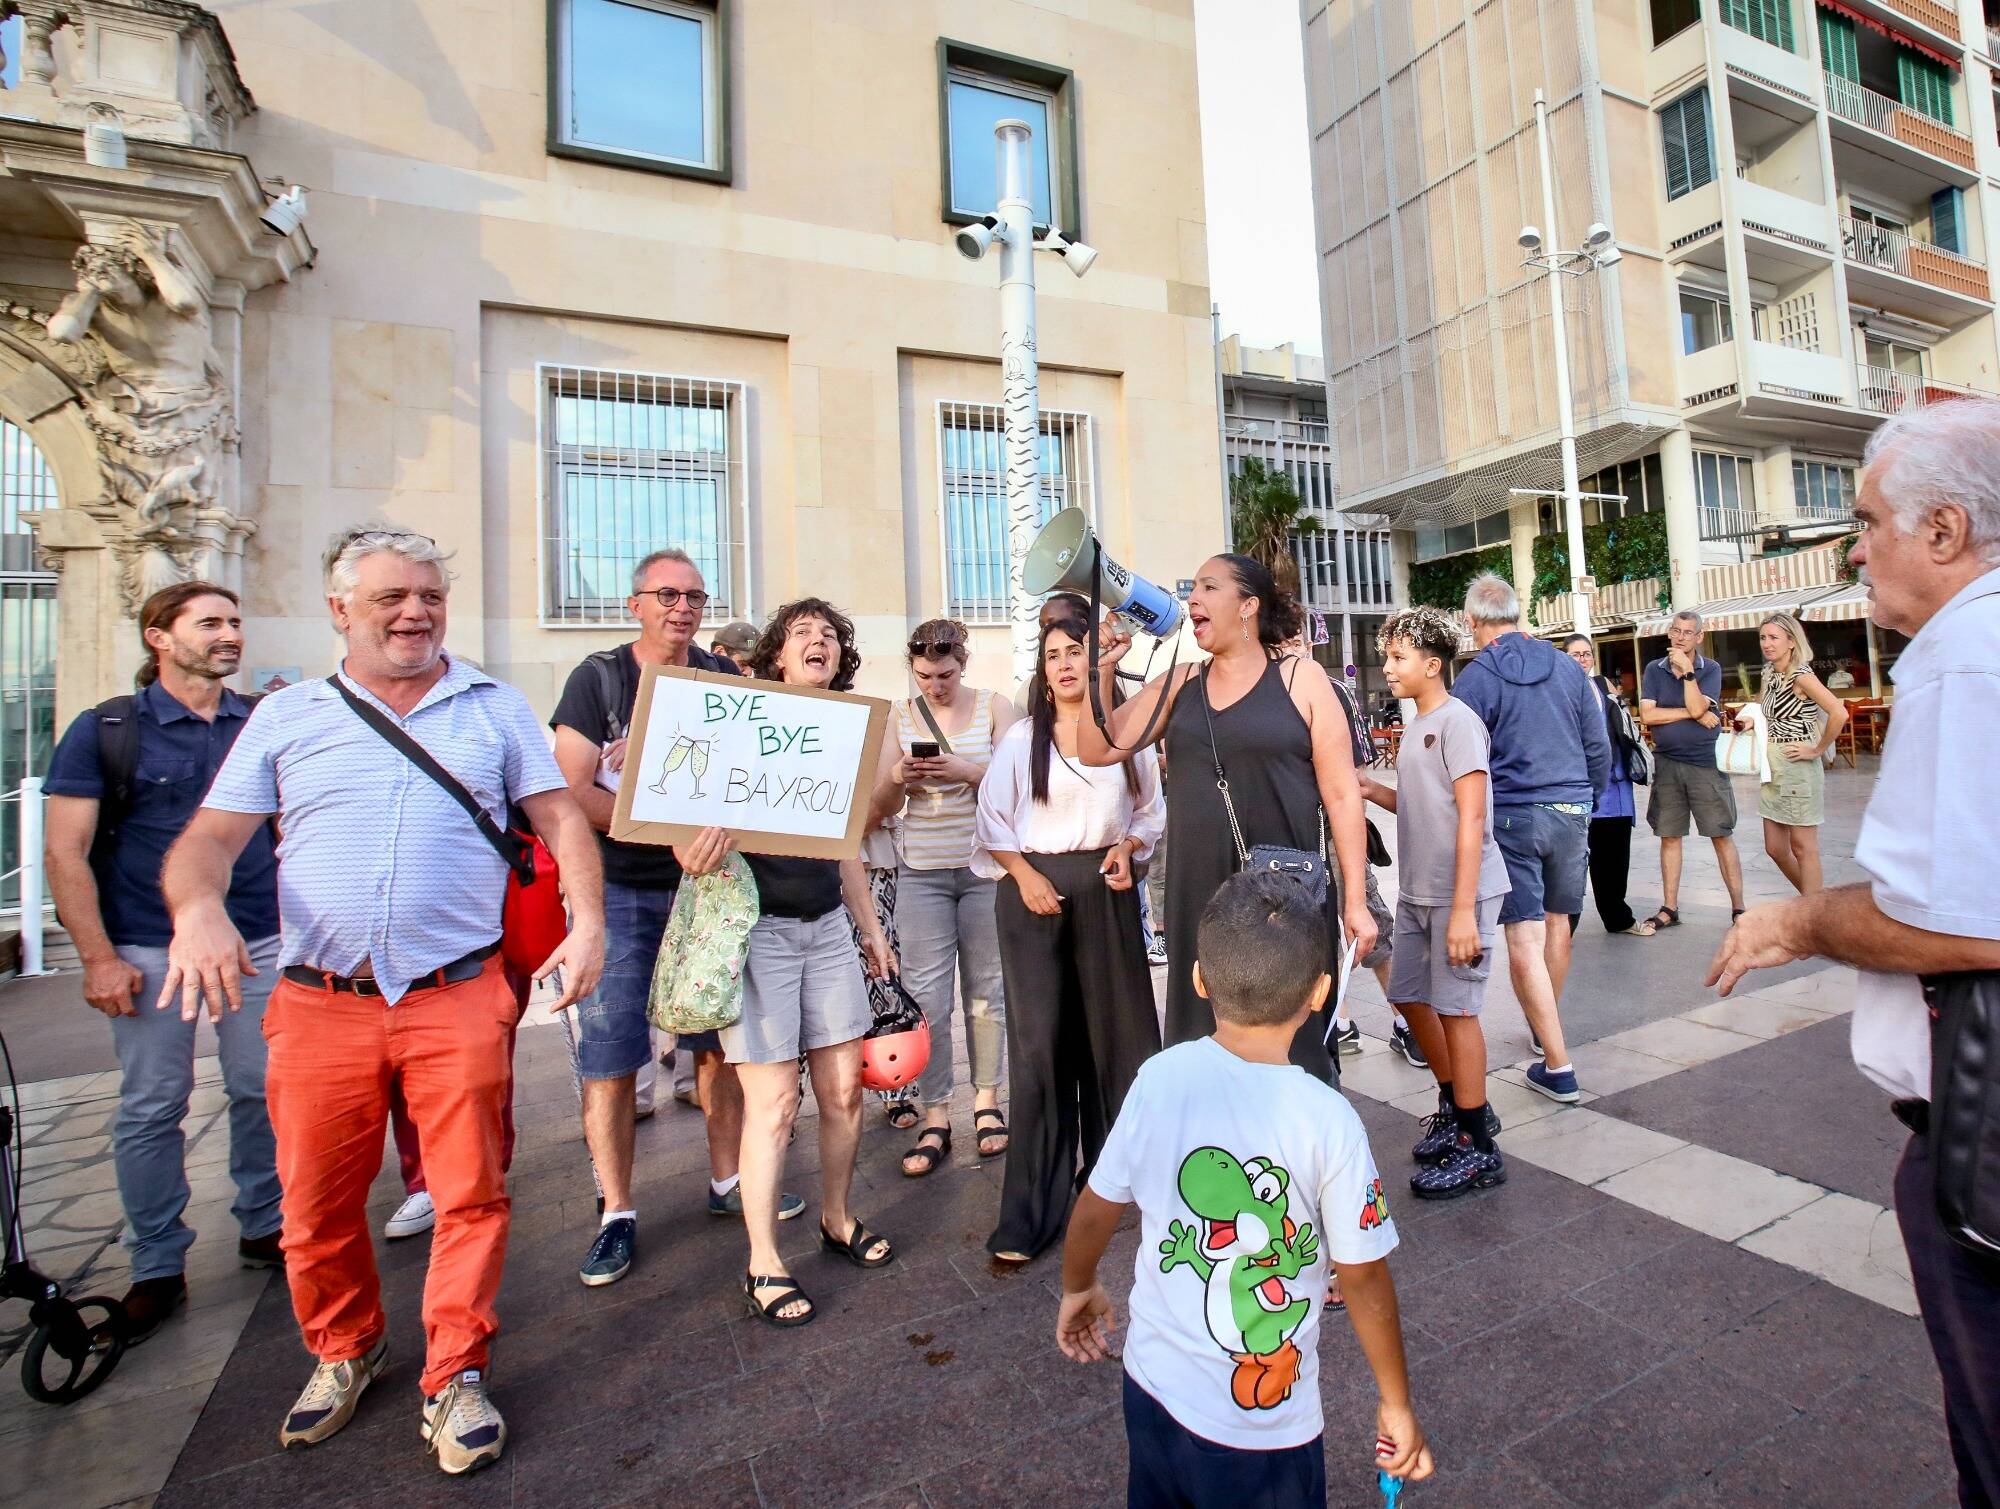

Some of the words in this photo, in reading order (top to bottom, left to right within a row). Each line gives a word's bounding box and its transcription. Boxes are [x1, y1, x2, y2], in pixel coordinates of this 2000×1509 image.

[704, 693, 768, 722] BYE
[759, 726, 823, 756] BYE
[724, 768, 851, 814] BAYROU
